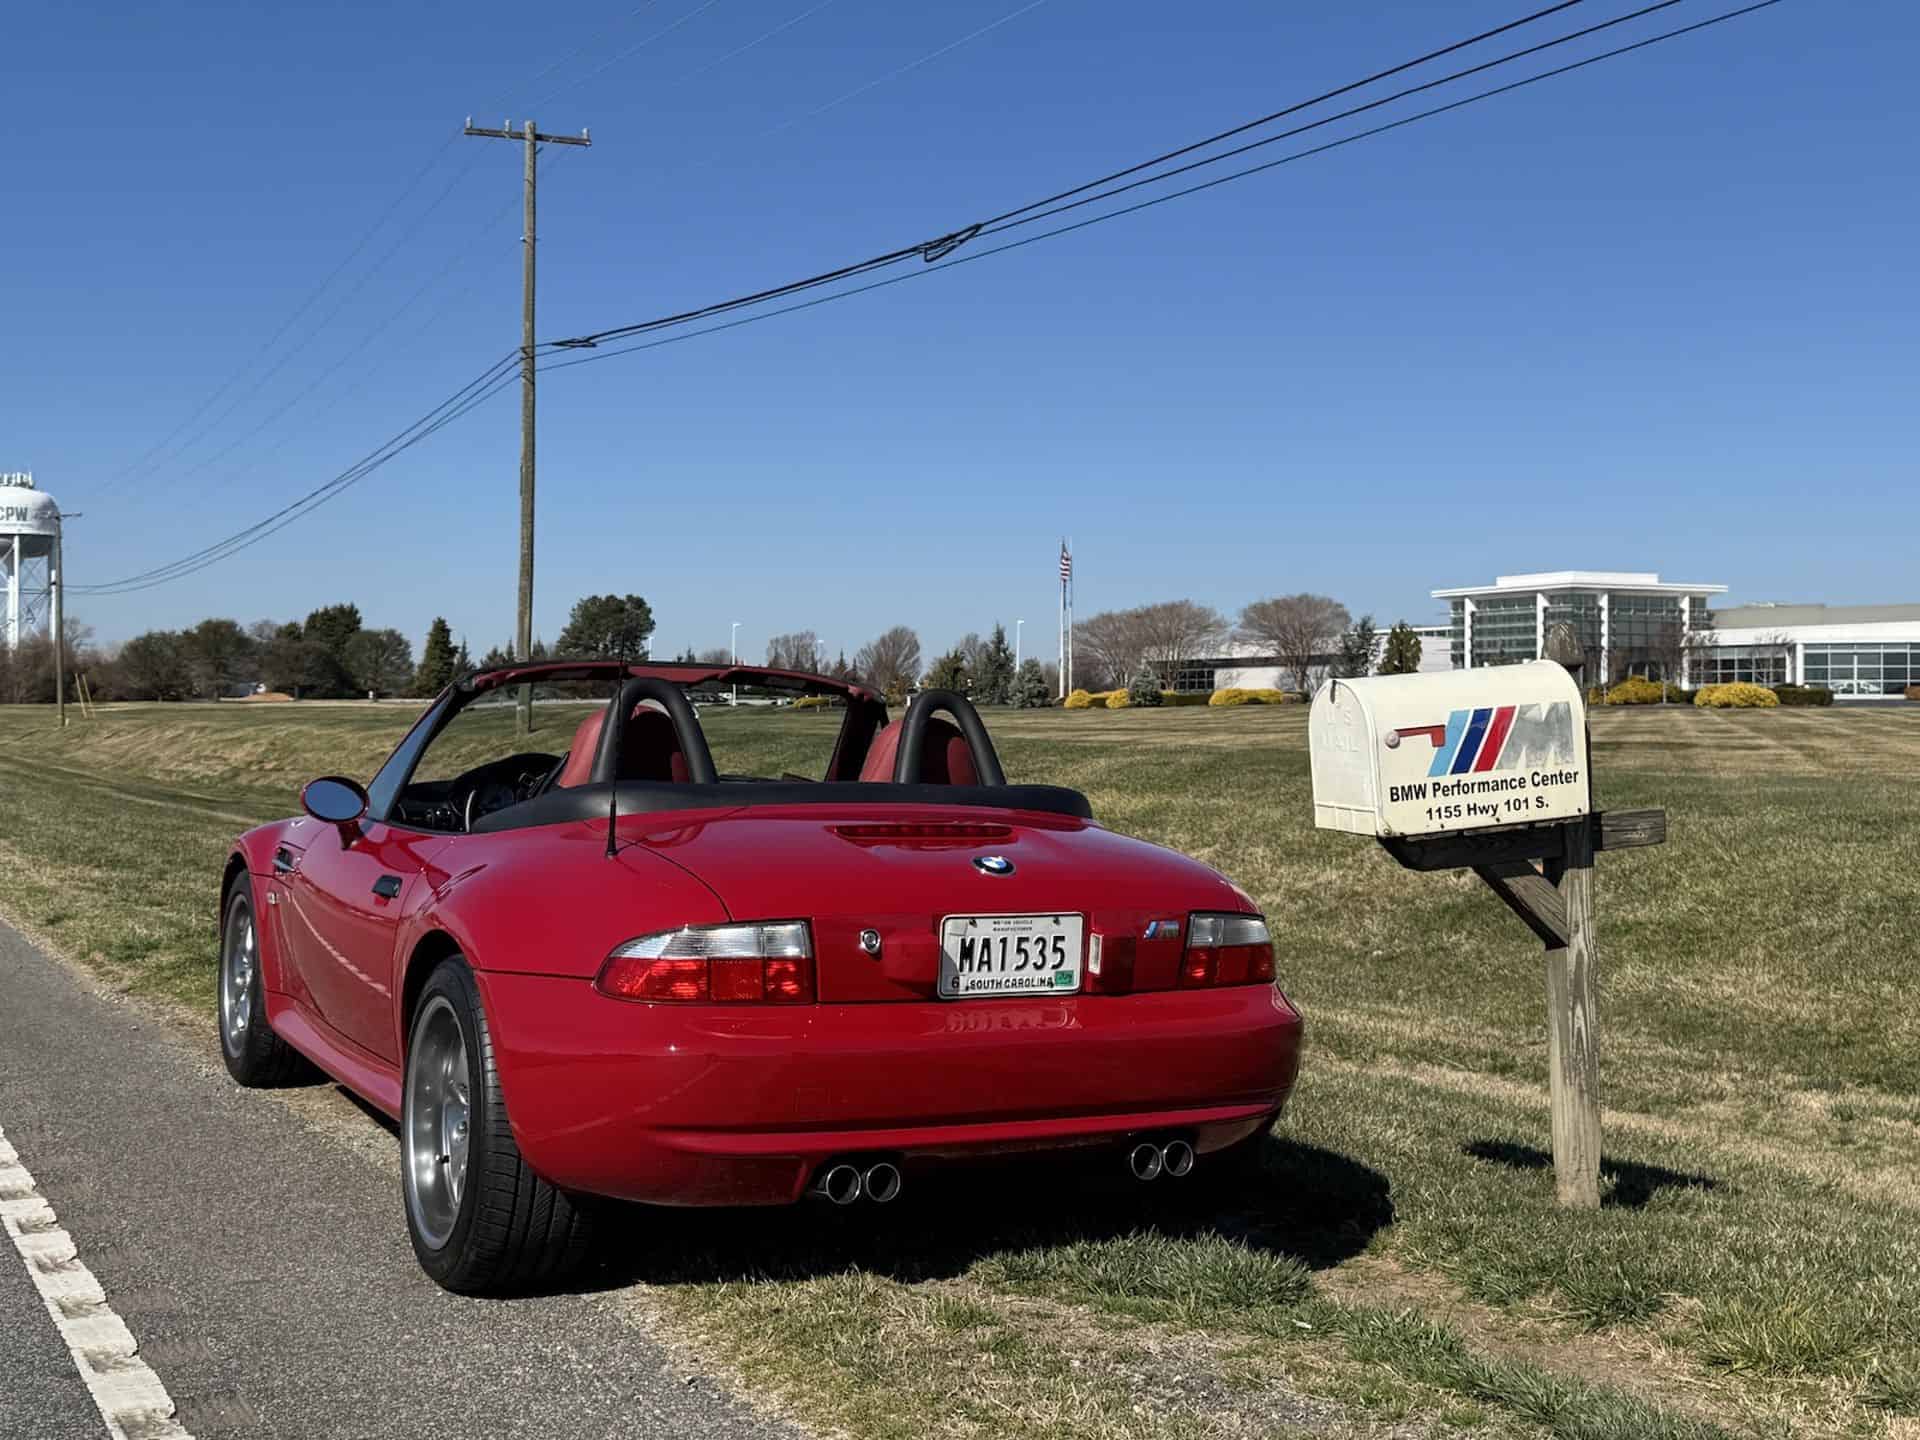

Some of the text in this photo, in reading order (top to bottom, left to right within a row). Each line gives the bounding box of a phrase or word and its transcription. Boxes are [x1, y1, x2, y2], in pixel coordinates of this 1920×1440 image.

[1389, 770, 1580, 803] BMW Performance Center
[1425, 796, 1550, 821] 1155 Hwy 101 S.
[958, 935, 1066, 973] MA1535
[969, 978, 1002, 990] SOUTH
[1004, 977, 1054, 989] CAROLINA
